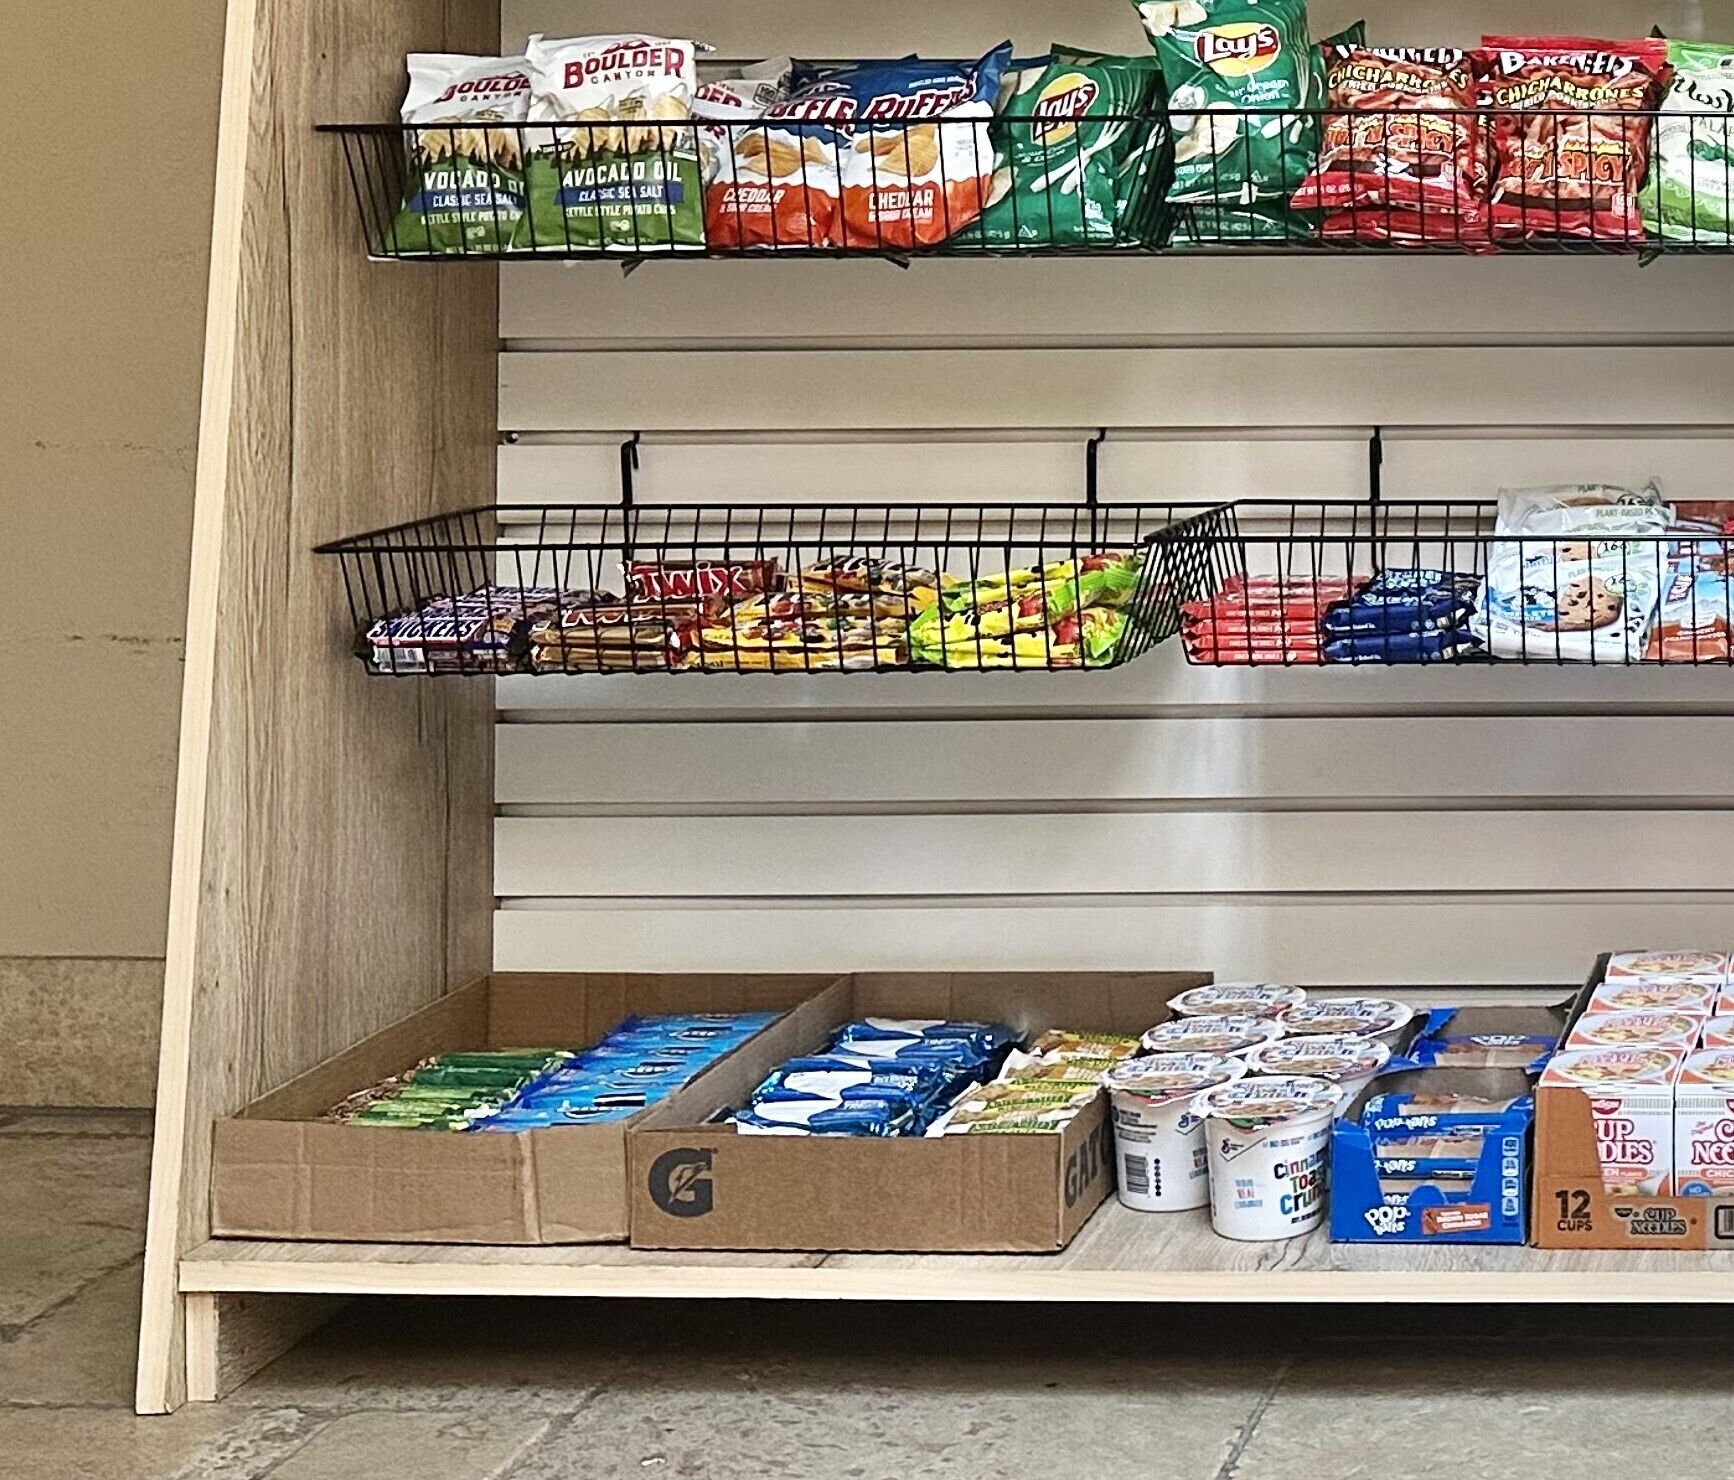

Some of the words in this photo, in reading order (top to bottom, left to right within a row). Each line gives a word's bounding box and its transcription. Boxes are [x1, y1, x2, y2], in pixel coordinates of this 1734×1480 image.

[1203, 25, 1276, 61] Lay's
[563, 48, 685, 89] BOULDER
[591, 70, 655, 85] CANYON
[1328, 64, 1469, 90] CHICHARROES
[1496, 76, 1644, 105] CHICHARRONES
[425, 171, 501, 190] VOCADO
[563, 162, 645, 188] AVOCADO
[653, 160, 683, 182] OIL
[475, 194, 492, 206] SEA
[618, 186, 637, 199] SEA
[640, 185, 664, 198] SALT
[723, 187, 785, 204] CHEDDAR
[1596, 1119, 1634, 1142] UP
[1599, 1140, 1653, 1164] DLES
[648, 1147, 716, 1218] G
[1555, 1189, 1591, 1219] 12
[1643, 1207, 1677, 1221] CUP
[1557, 1219, 1593, 1232] CUPS
[1630, 1219, 1687, 1234] NOODLES
